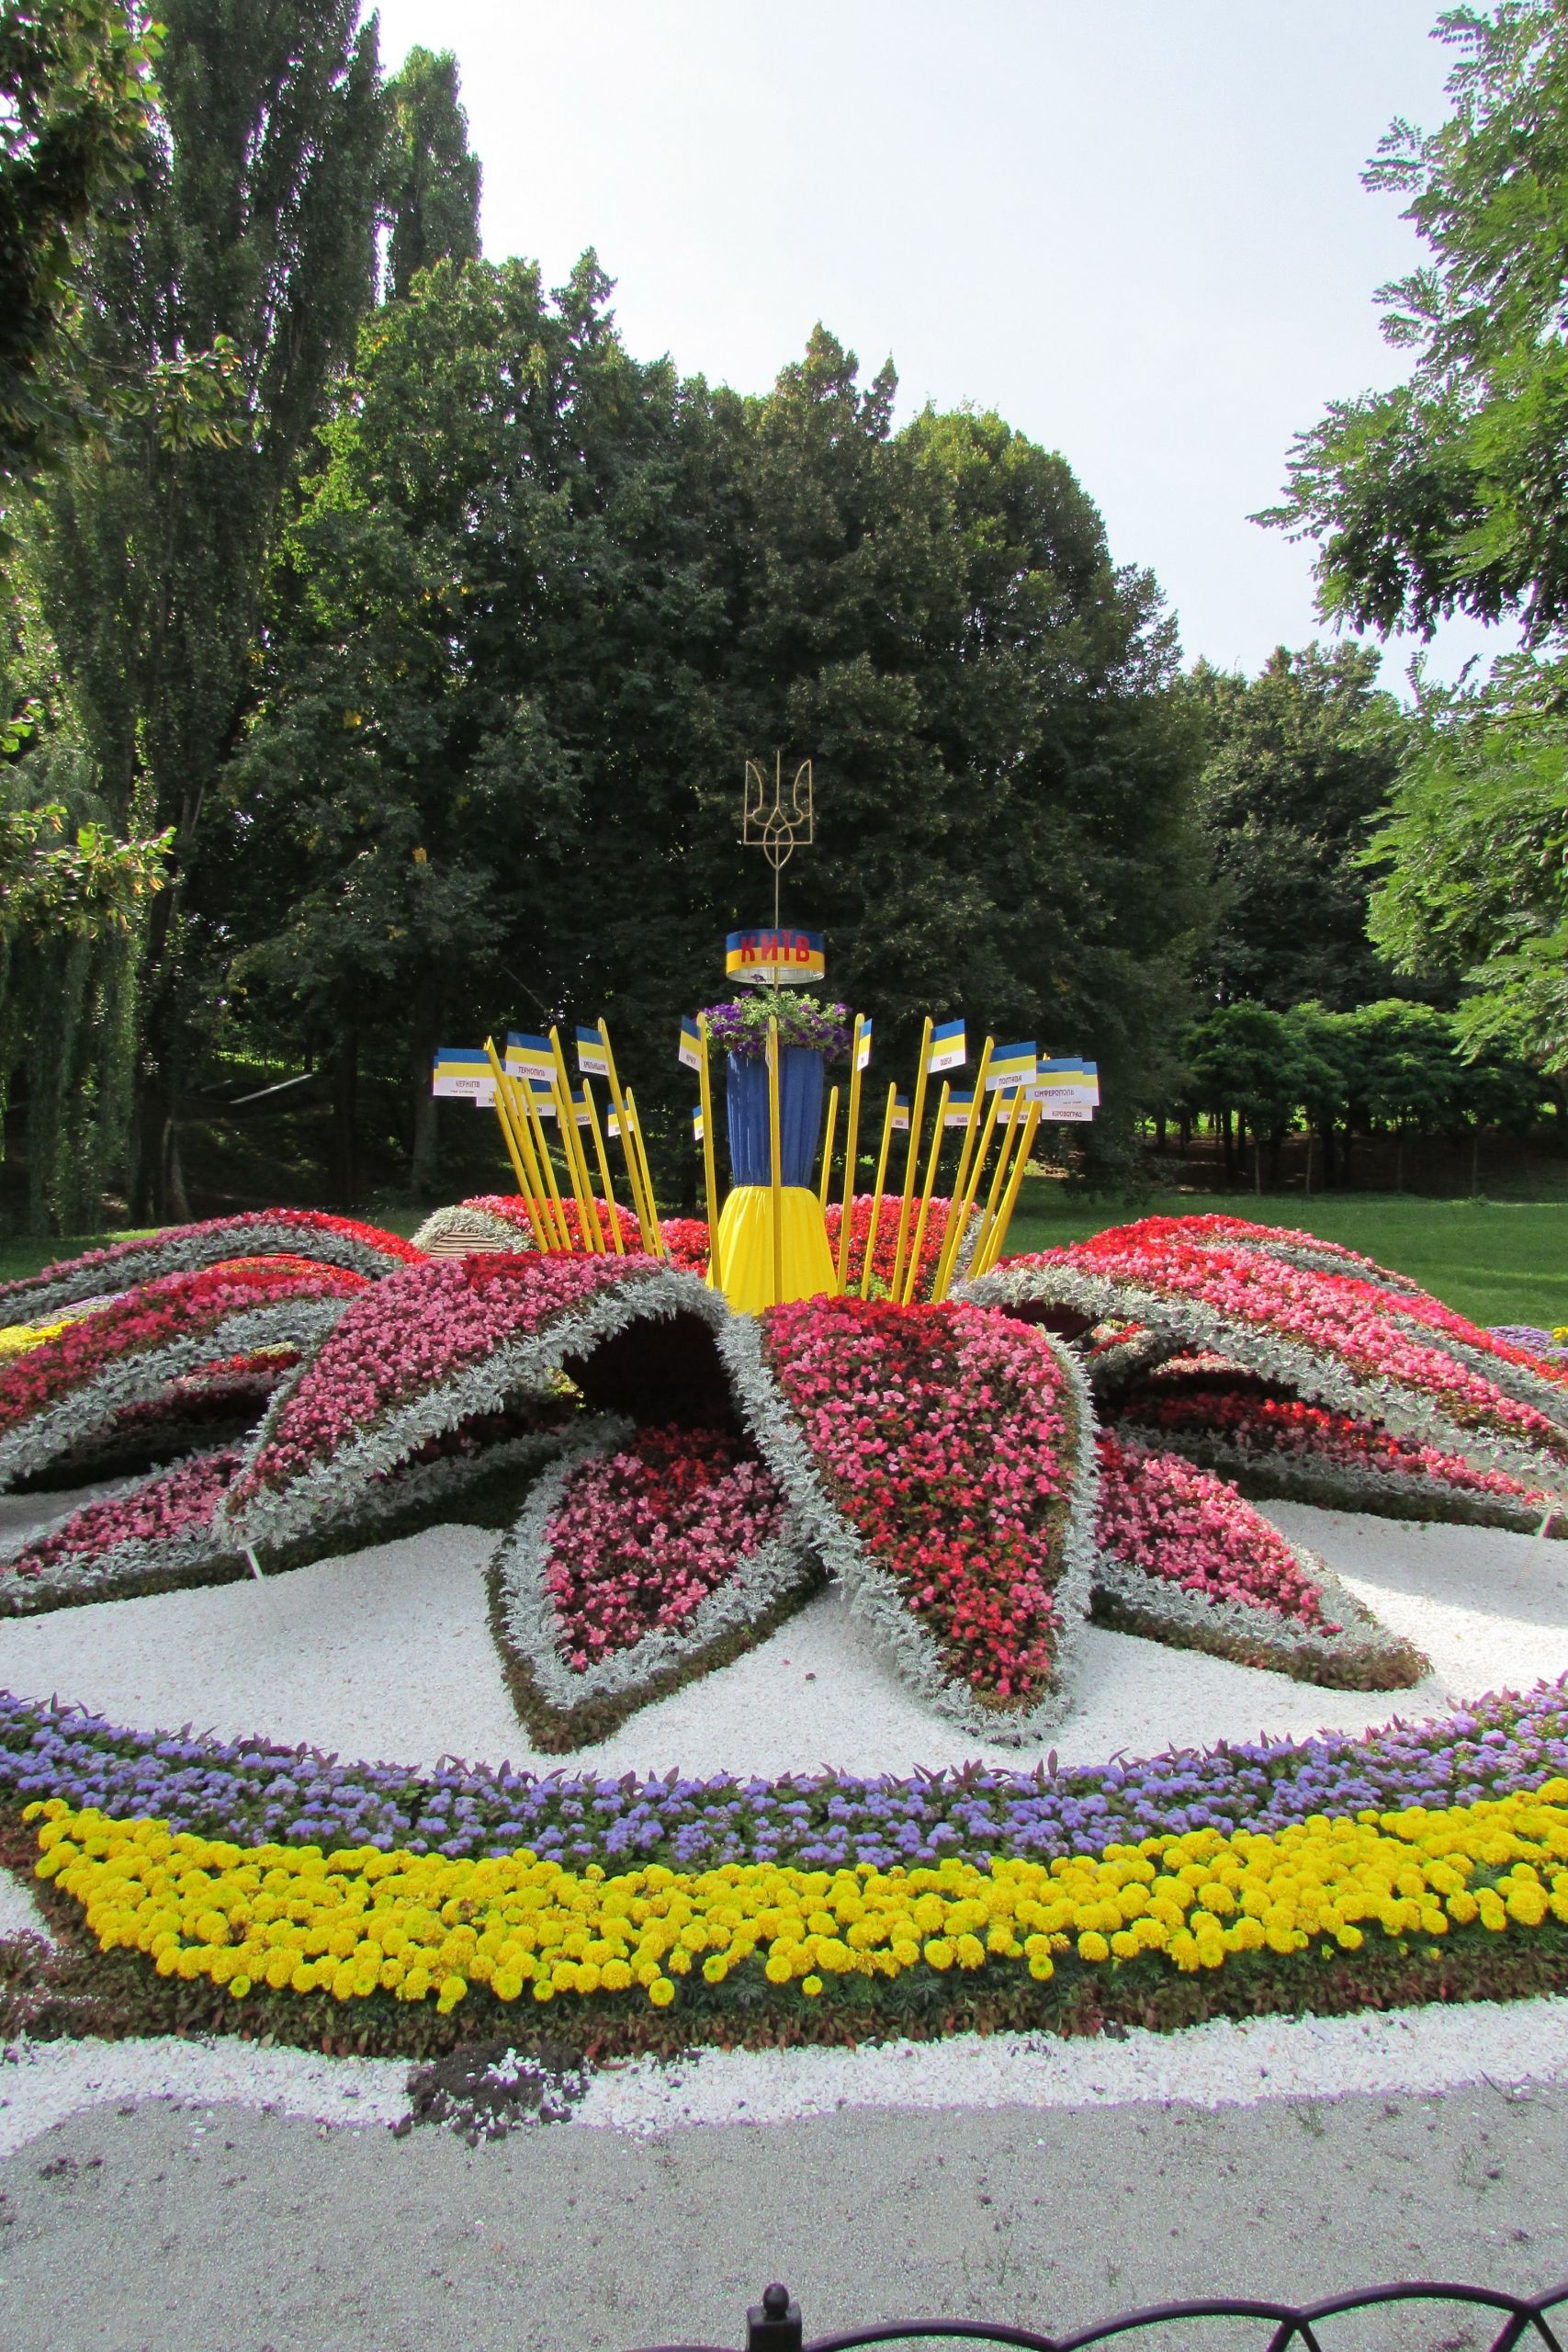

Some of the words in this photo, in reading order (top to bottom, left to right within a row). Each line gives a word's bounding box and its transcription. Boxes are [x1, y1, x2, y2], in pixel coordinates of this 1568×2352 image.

[740, 930, 810, 963] КИЇВ
[518, 1066, 546, 1077] ТЕРНОПІЛЬ
[998, 1075, 1022, 1086] ПОЛТАВА
[1034, 1089, 1075, 1098] СІМФЕРОПОЛЬ
[1051, 1110, 1083, 1118] КІРОВОГРАД
